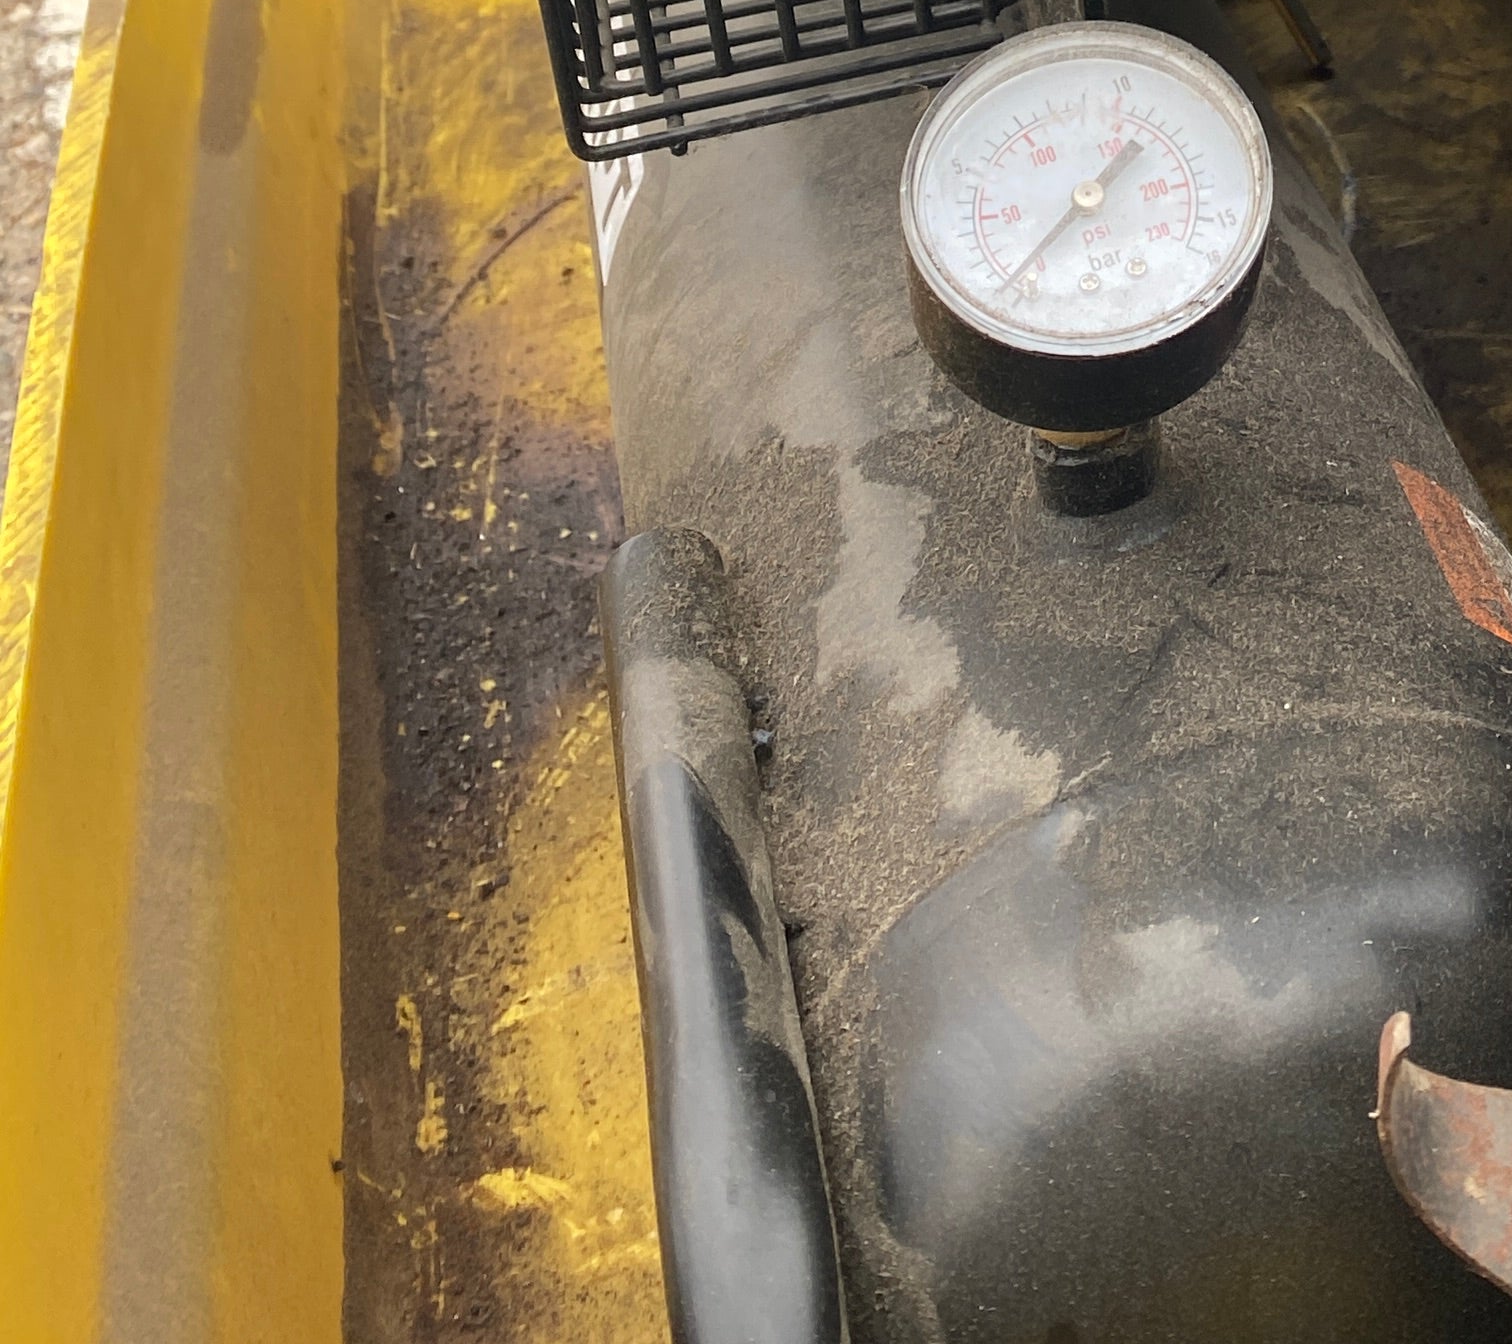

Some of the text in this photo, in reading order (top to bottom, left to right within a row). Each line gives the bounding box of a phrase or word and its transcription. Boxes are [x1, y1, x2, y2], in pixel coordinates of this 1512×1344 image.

[1113, 76, 1131, 94] 10
[1030, 146, 1057, 167] 100
[1098, 137, 1123, 159] 150
[1140, 179, 1169, 202] 200
[1001, 205, 1021, 224] 50
[1217, 208, 1237, 228] 15
[1083, 223, 1111, 246] psi
[1145, 223, 1170, 243] 230
[1088, 249, 1121, 272] bar
